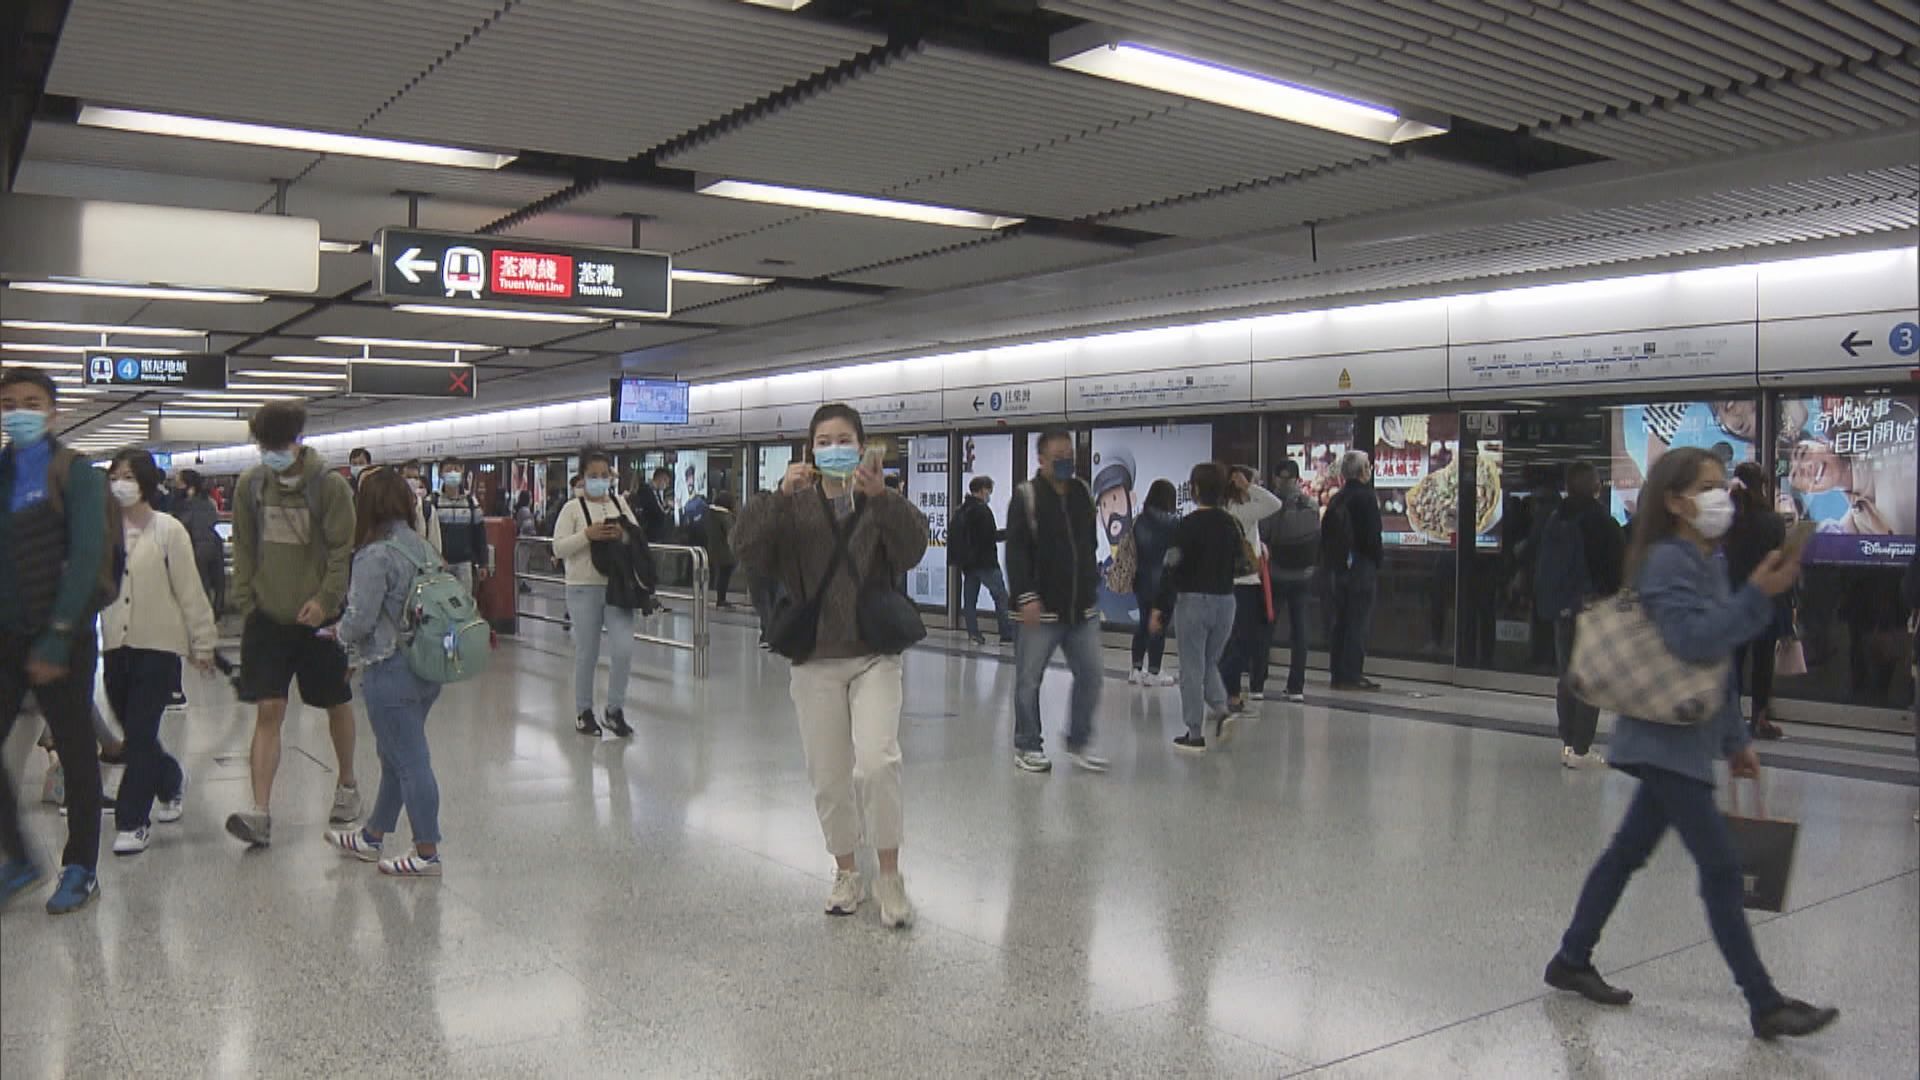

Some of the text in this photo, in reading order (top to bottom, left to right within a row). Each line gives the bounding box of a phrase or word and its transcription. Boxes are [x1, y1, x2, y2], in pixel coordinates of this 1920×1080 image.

[578, 262, 615, 285] 荃灣
[499, 278, 565, 293] Tsuen Wan Line
[578, 284, 623, 298] Tsuen Wan
[1899, 328, 1912, 350] 3
